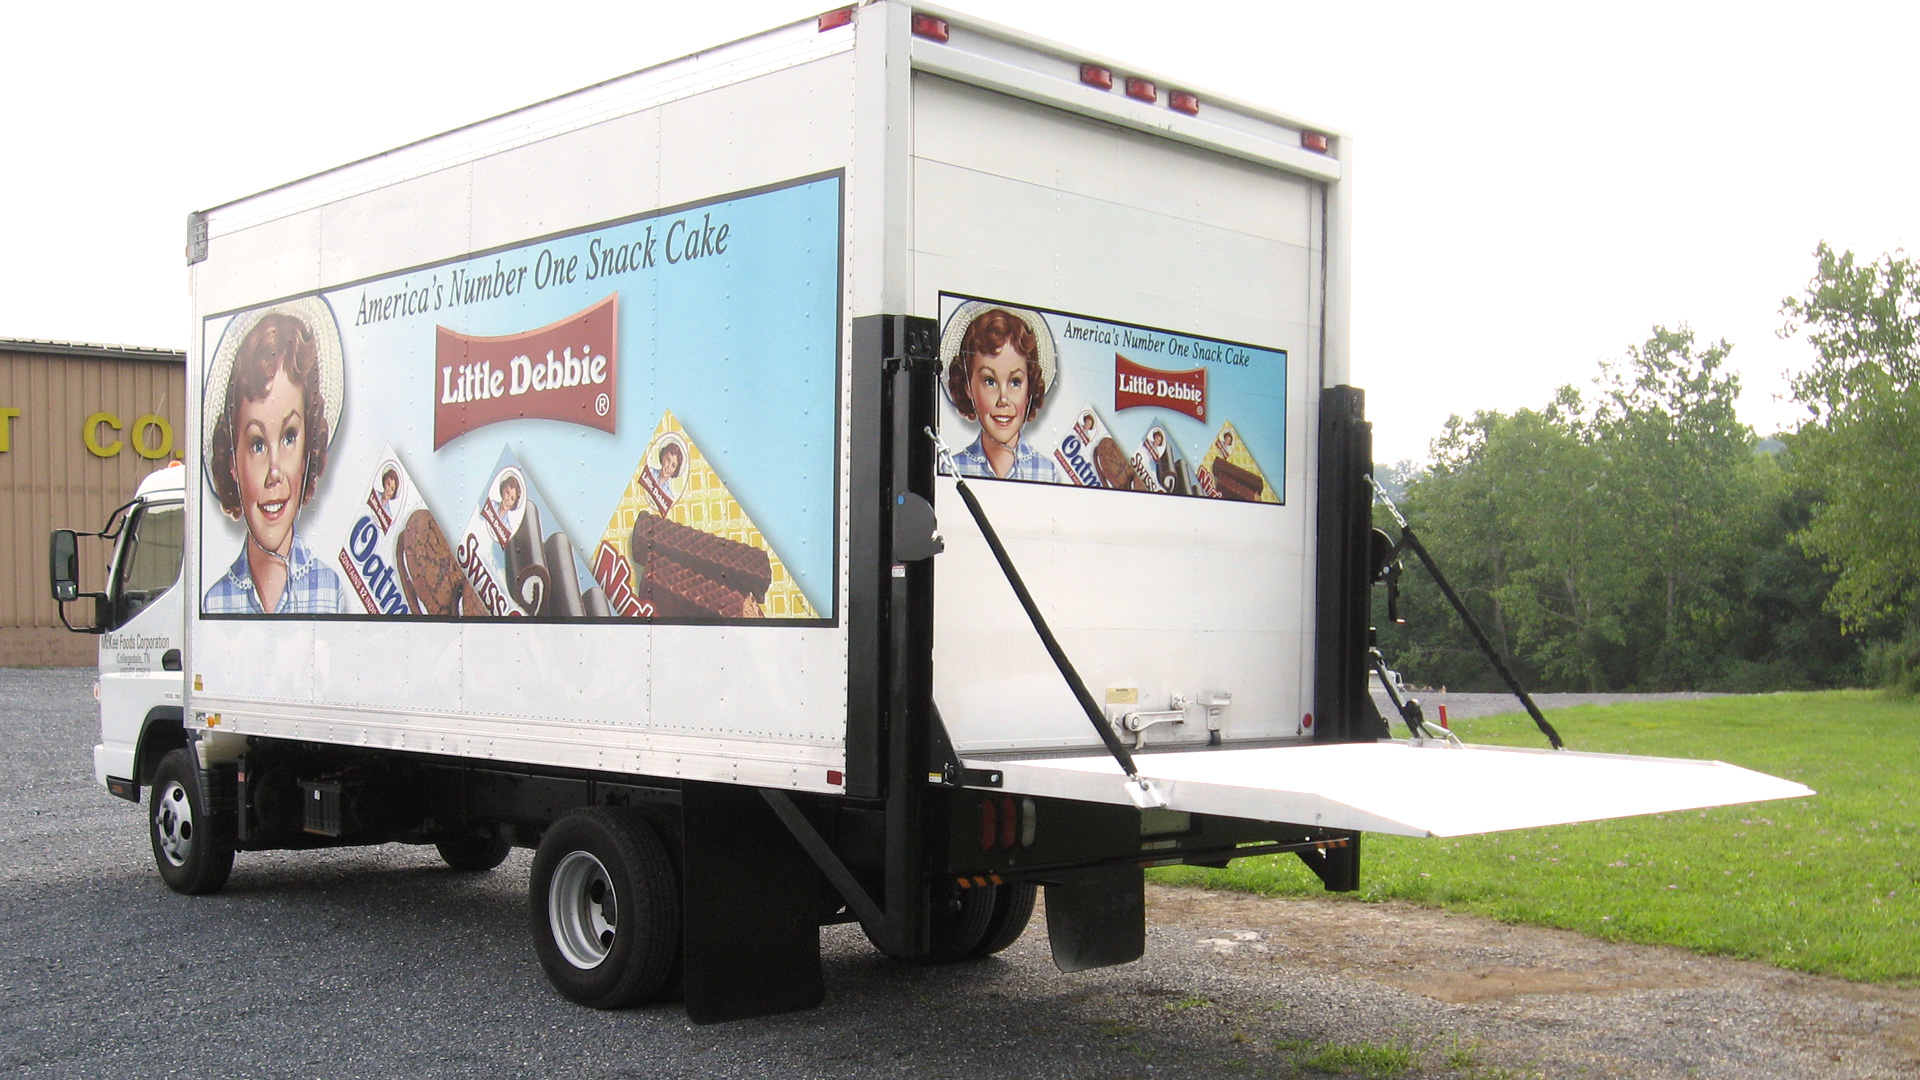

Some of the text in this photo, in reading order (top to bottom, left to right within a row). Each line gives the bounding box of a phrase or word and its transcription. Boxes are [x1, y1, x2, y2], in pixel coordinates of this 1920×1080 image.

[355, 212, 730, 326] America's Number One Snack Cake
[1063, 320, 1250, 367] America's Number One Snack Cake
[441, 344, 607, 404] Little Debbie
[1119, 373, 1202, 402] Little Debbie
[84, 412, 184, 459] CO.
[652, 487, 669, 512] Debbie
[339, 551, 362, 589] CONTAINS
[359, 587, 369, 598] 12
[120, 633, 135, 650] Foods
[136, 633, 170, 653] Corporation
